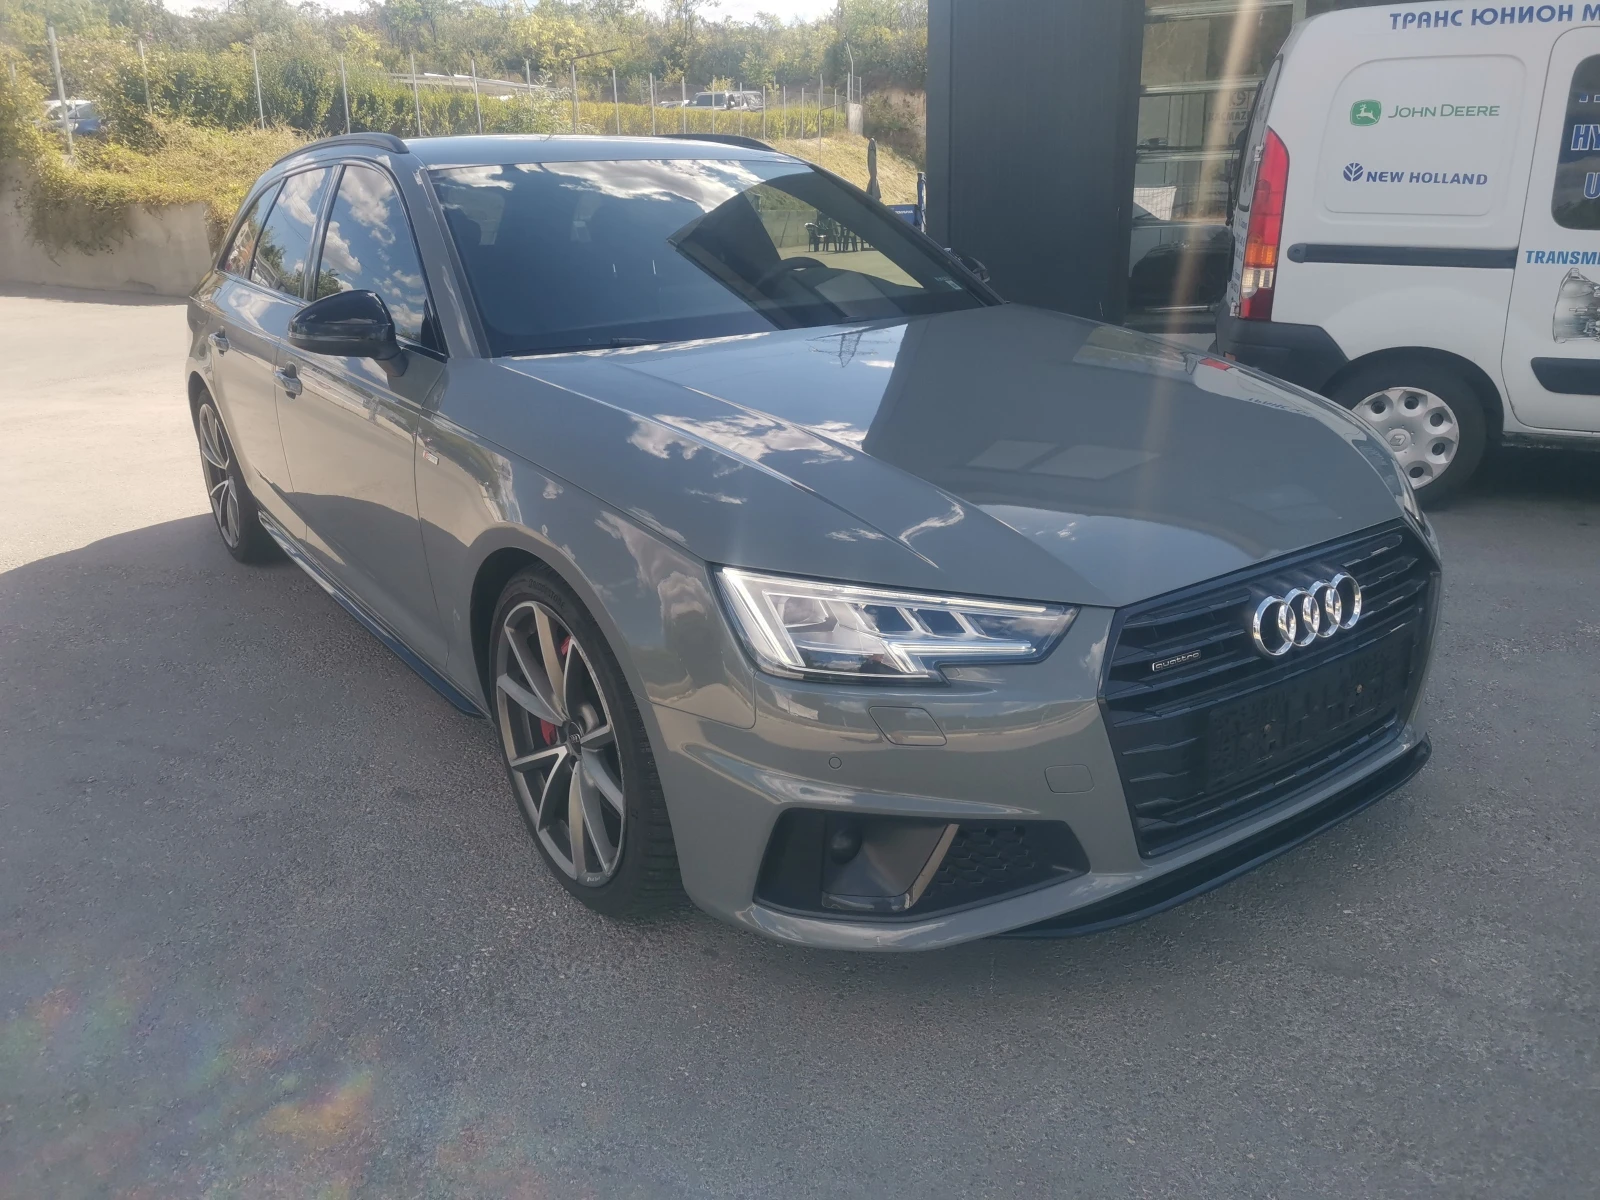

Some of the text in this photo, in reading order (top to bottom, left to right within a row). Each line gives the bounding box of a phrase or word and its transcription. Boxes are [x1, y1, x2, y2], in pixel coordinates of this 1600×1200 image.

[1389, 9, 1463, 30] ТРАНС
[1470, 4, 1573, 26] ЮНИОН
[1388, 104, 1500, 118] JOHN DEERE
[1366, 171, 1488, 185] NEW HOLLAND
[1155, 652, 1200, 669] quattro
